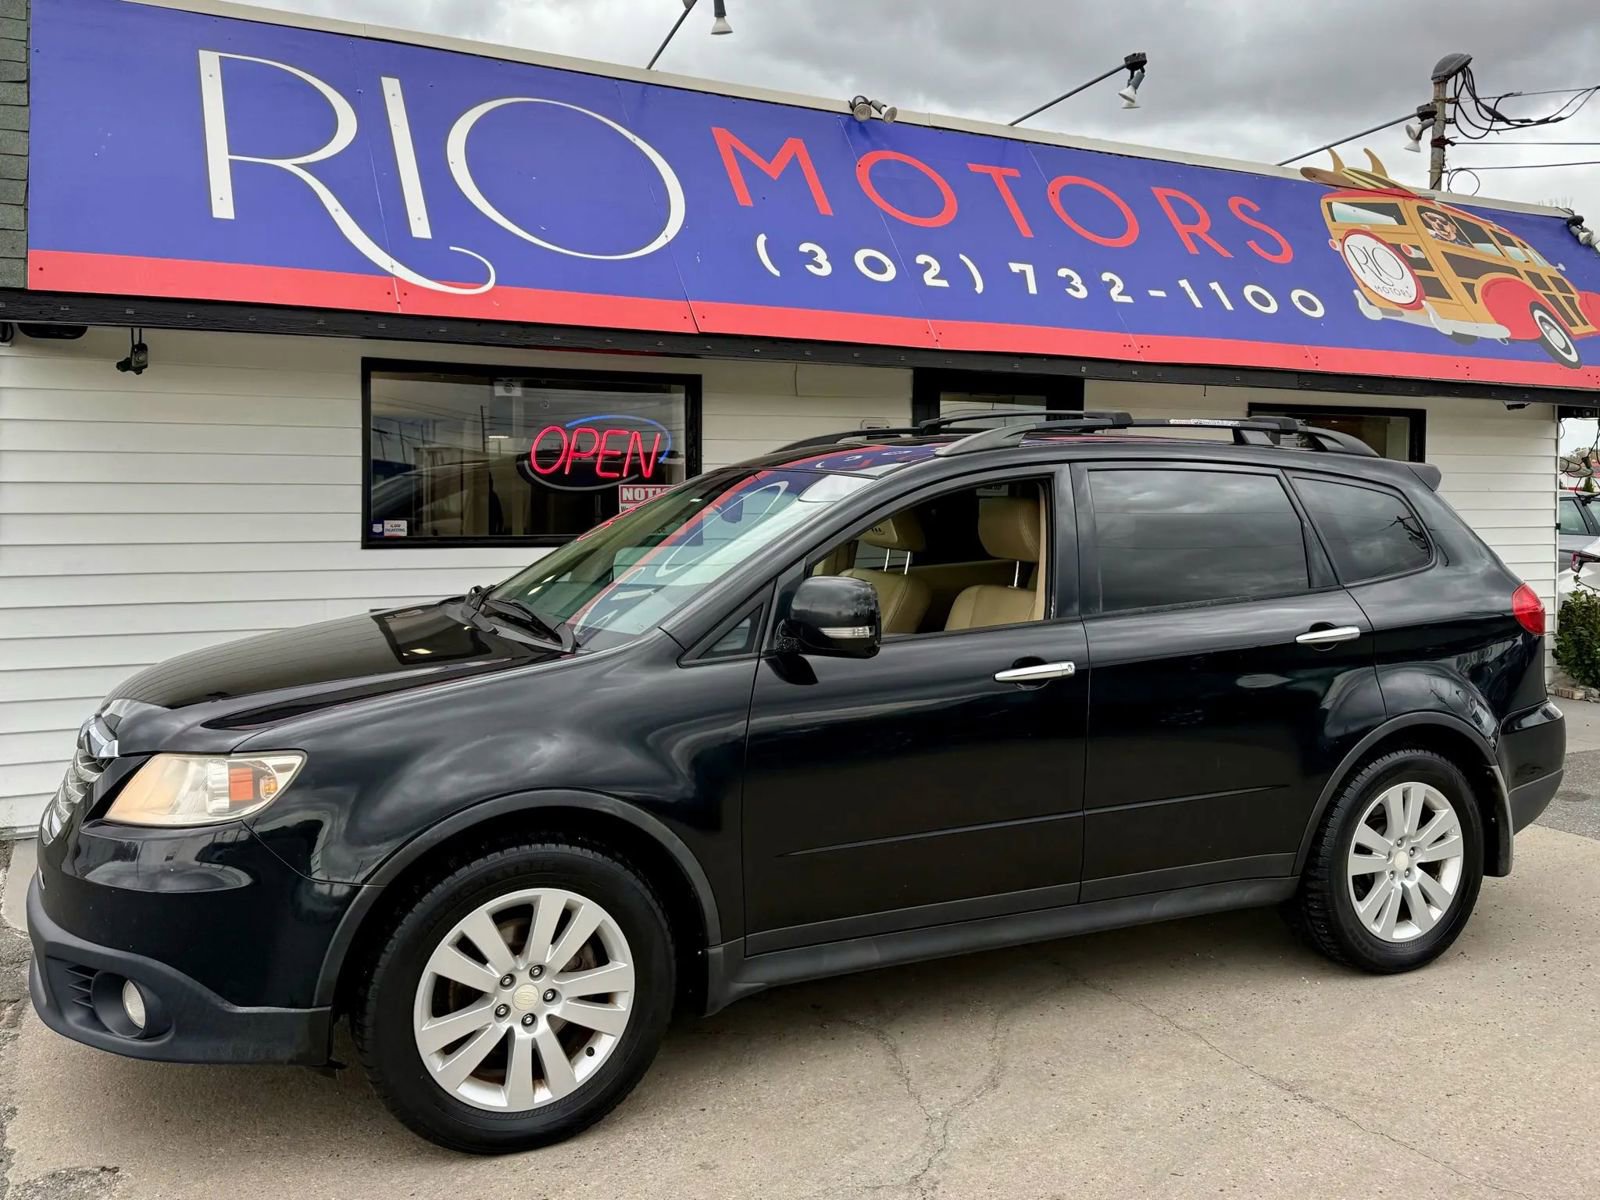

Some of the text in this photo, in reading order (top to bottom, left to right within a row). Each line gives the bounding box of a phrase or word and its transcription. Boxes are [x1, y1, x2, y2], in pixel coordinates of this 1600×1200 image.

[198, 49, 1294, 295] RIO MOTORS
[756, 233, 1325, 318] (302) 732-1100
[1346, 244, 1404, 287] RIO
[530, 425, 661, 478] OPEN
